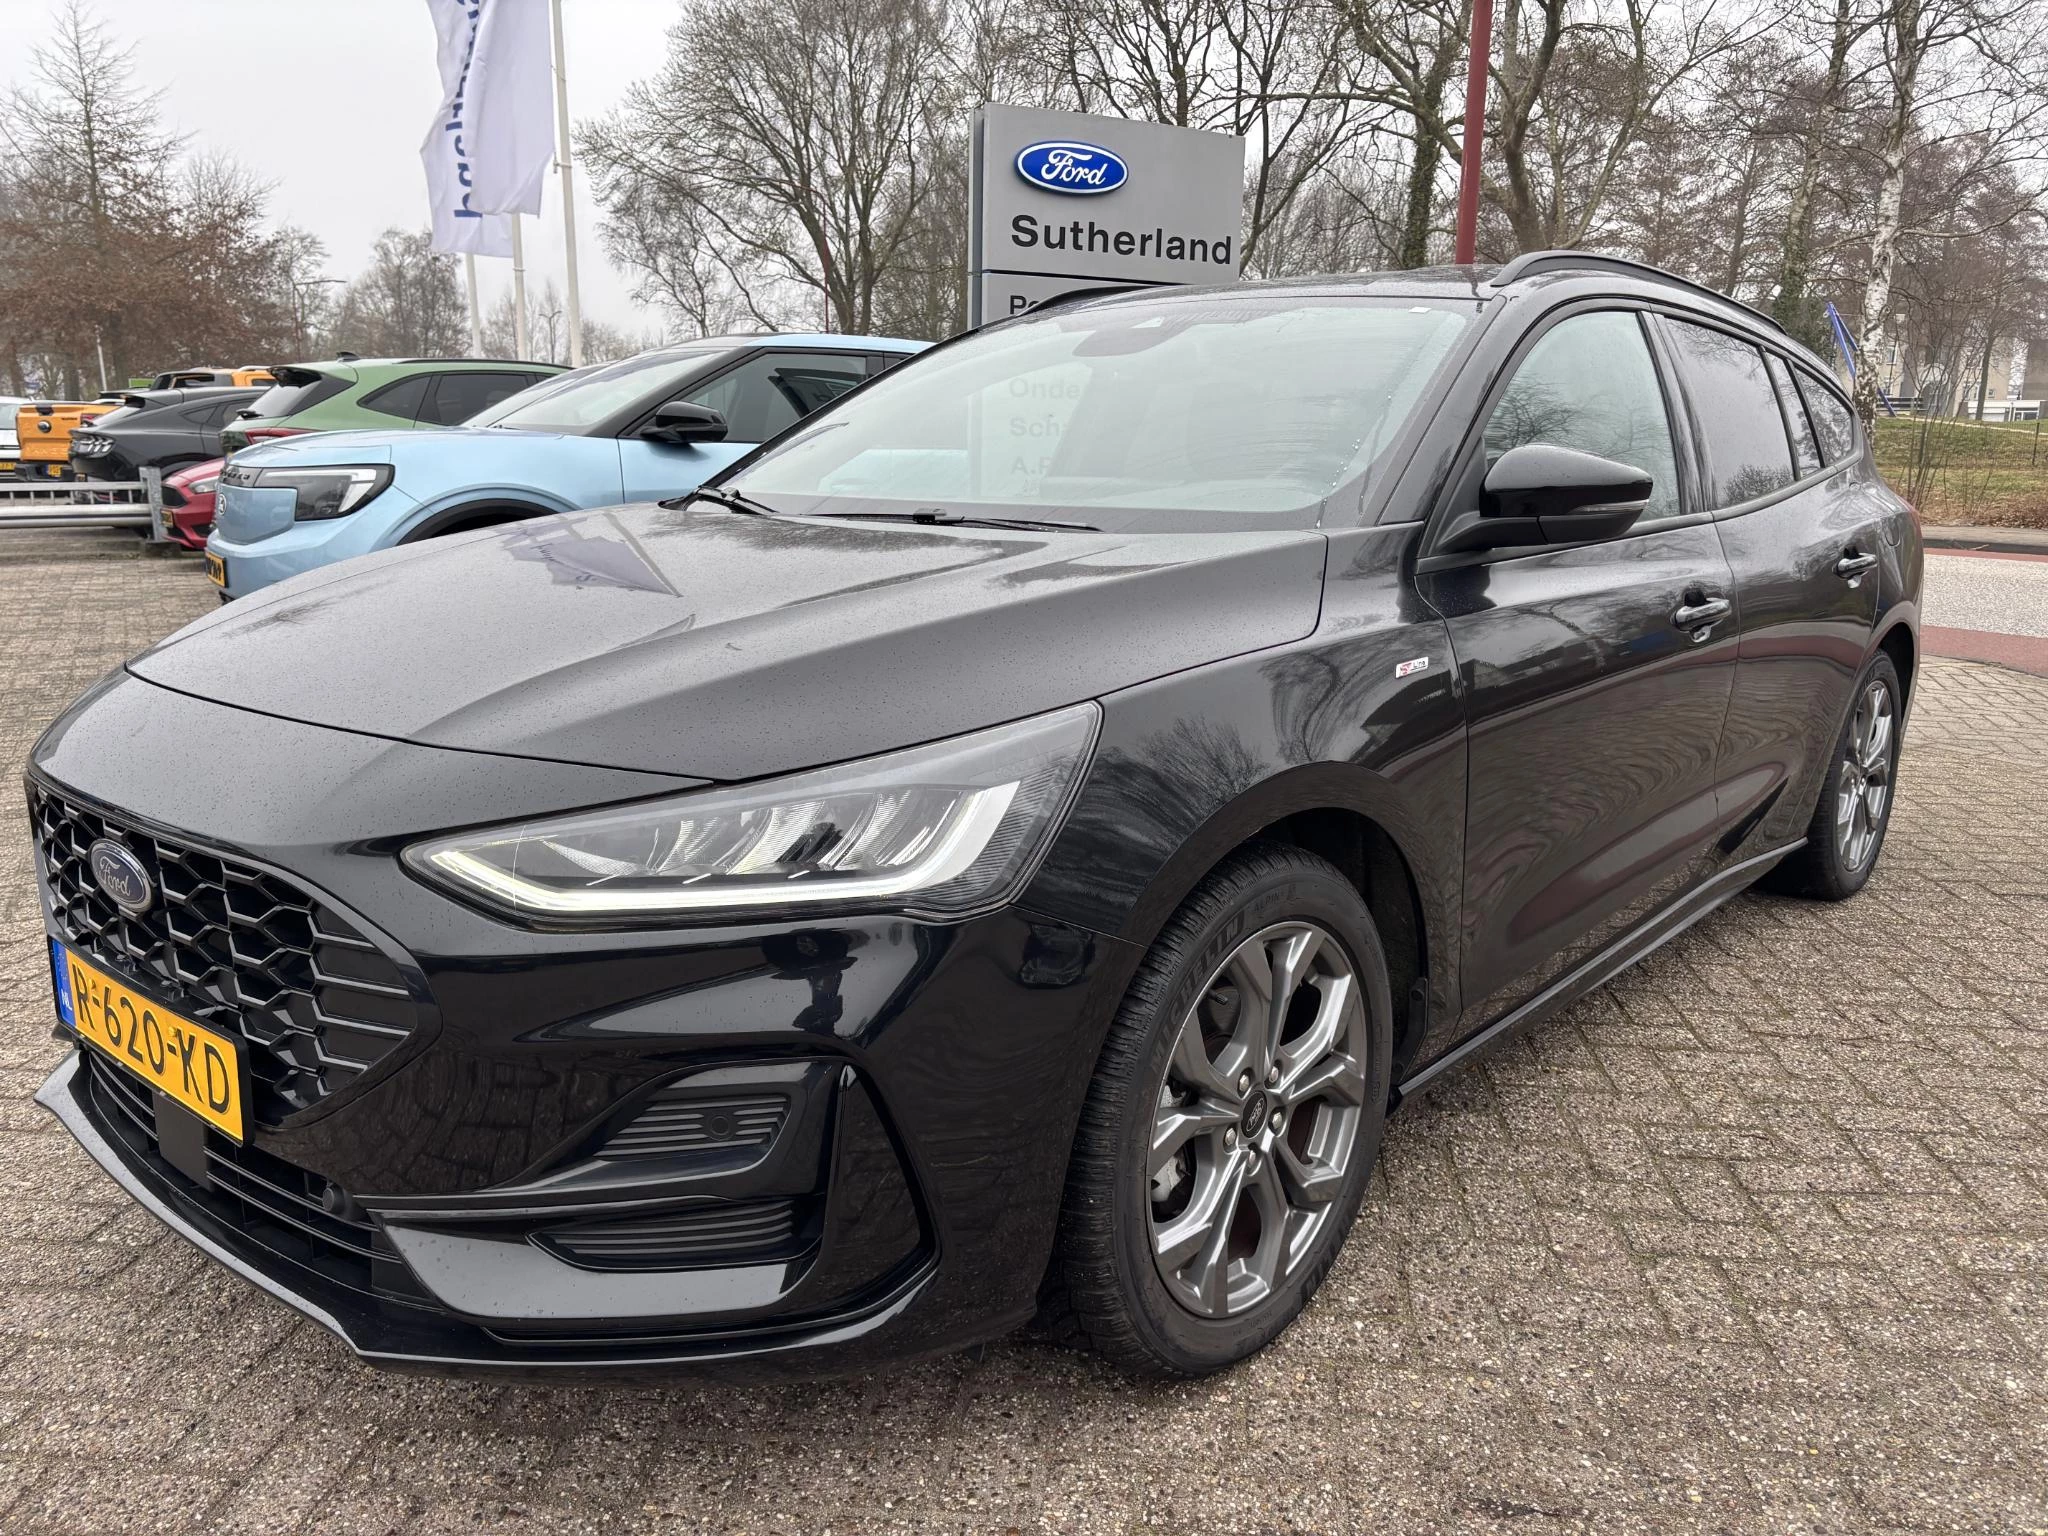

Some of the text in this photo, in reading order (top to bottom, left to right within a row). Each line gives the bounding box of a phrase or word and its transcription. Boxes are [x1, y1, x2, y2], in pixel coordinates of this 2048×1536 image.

[1041, 148, 1108, 185] Ford
[1011, 214, 1232, 265] Sutherland
[97, 855, 131, 898] Ford
[60, 992, 72, 1011] NL
